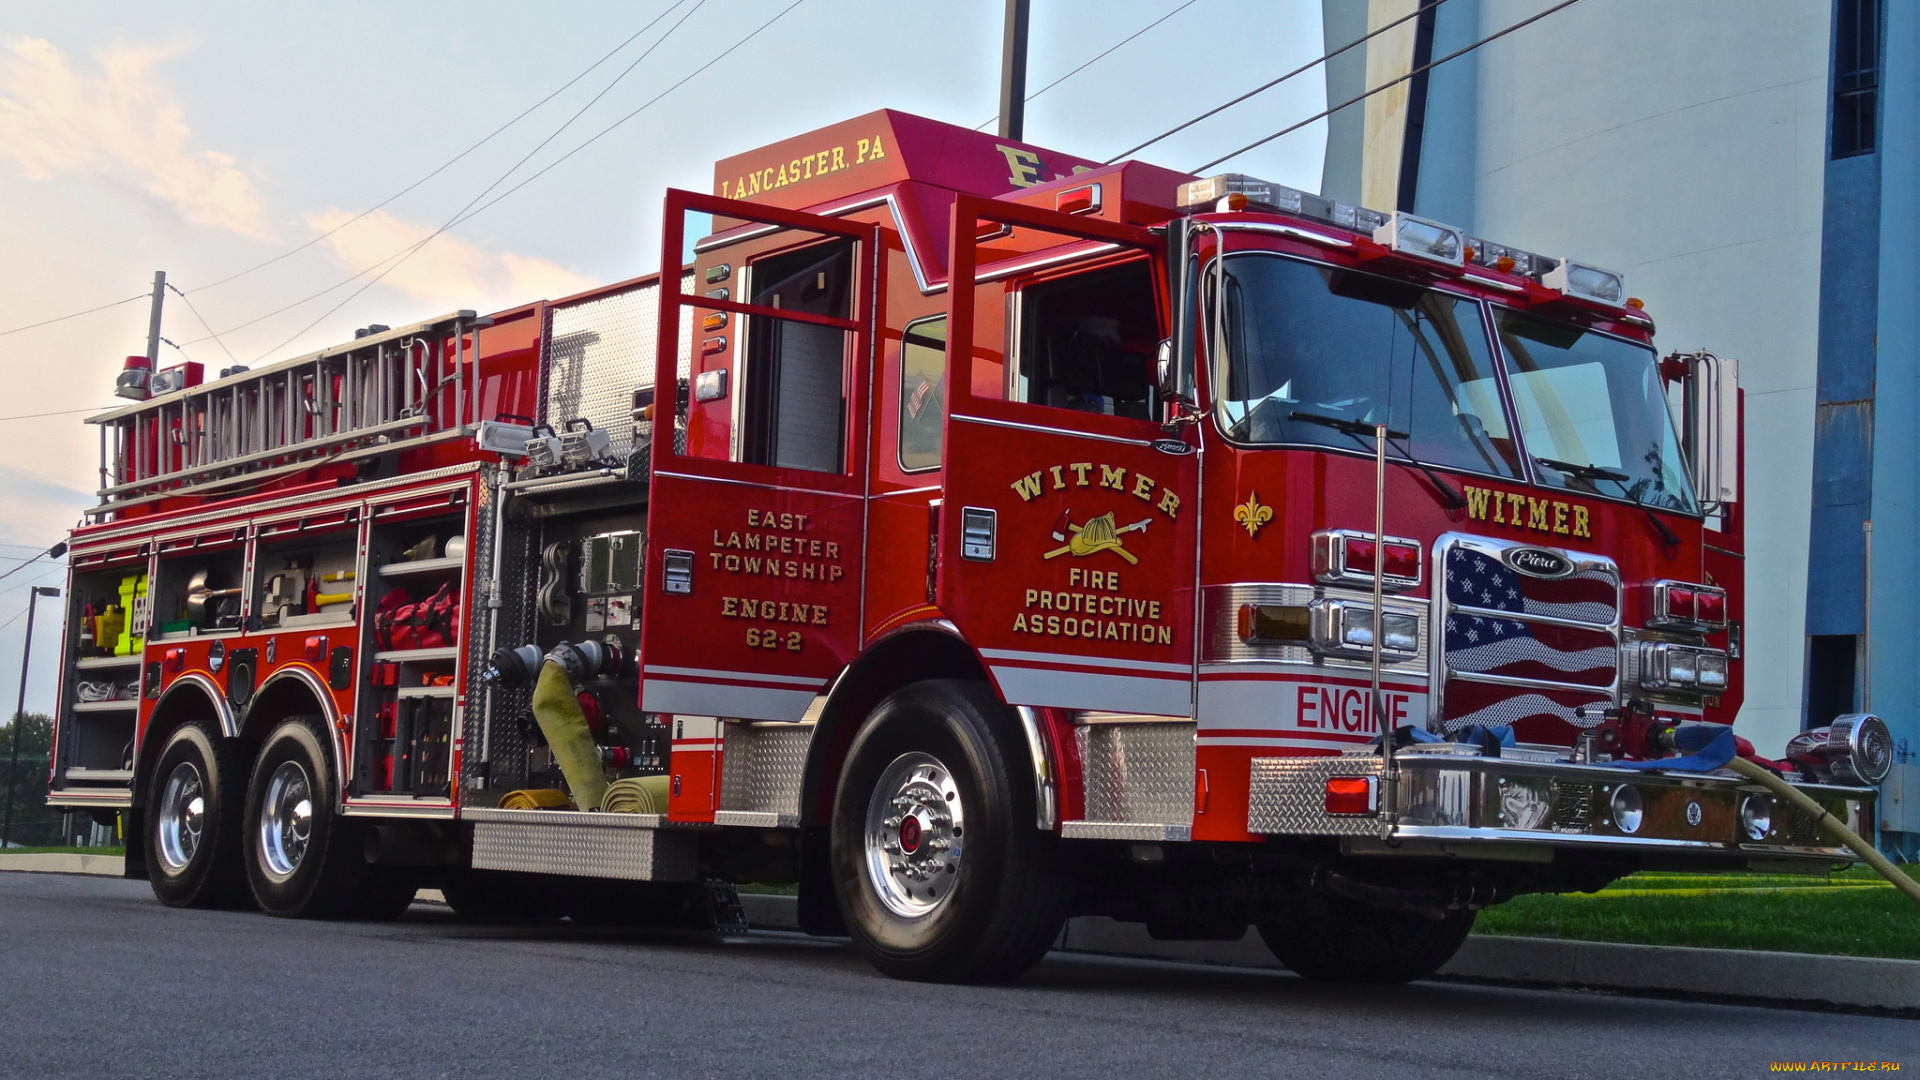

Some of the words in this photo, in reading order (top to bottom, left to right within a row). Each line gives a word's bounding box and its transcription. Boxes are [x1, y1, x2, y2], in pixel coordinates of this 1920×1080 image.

[856, 135, 885, 164] PA
[1010, 462, 1181, 518] WITMER
[748, 509, 807, 531] EAST
[1464, 485, 1591, 538] WITMER
[713, 529, 839, 558] LAMPETER
[710, 552, 843, 581] TOWNSHIP
[1517, 550, 1559, 569] Pierce
[1070, 568, 1119, 591] FIRE
[721, 596, 828, 625] ENGINE
[1026, 589, 1160, 620] PROTECTIVE
[1012, 612, 1171, 645] ASSOCIATION
